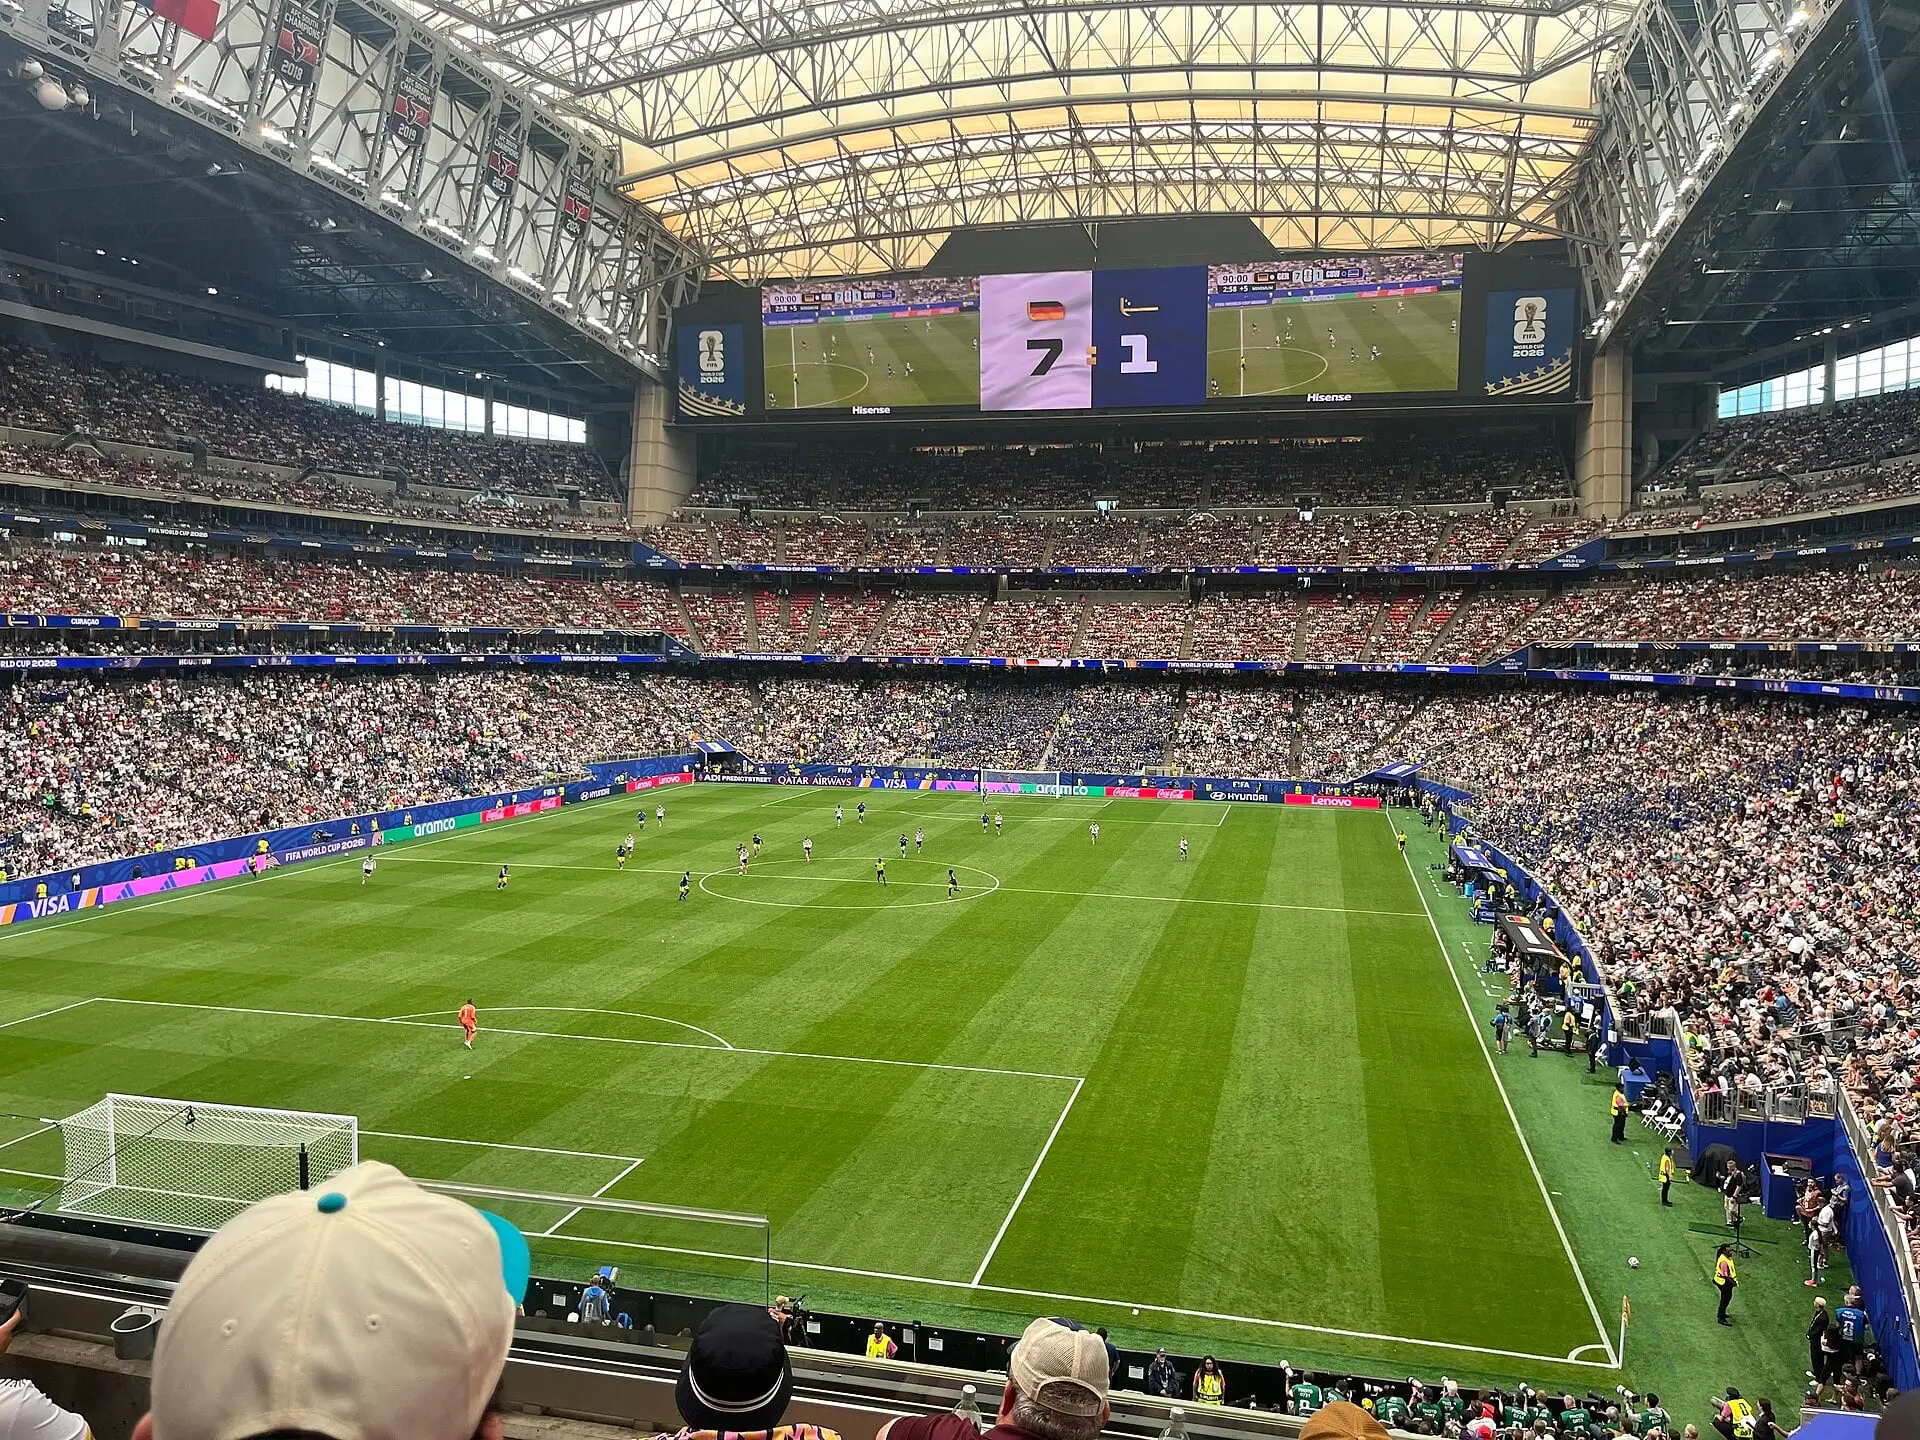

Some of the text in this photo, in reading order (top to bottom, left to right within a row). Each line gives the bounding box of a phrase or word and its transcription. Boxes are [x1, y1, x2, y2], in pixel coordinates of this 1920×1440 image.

[290, 7, 301, 18] AFC
[284, 12, 321, 40] CHAMPIONS
[281, 59, 303, 81] 2018
[400, 80, 432, 105] CHAMPIONS
[397, 123, 417, 142] 2019
[1222, 274, 1248, 284] 90:00
[774, 295, 797, 303] 90:00
[1026, 338, 1064, 376] 7
[1120, 334, 1158, 374] 1
[1512, 349, 1545, 358] 2026
[1306, 393, 1352, 402] Hisense
[852, 406, 891, 415] Hisense
[160, 528, 179, 536] WORLD
[415, 550, 448, 558] HOUSTON
[1796, 547, 1827, 556] HOUSTON
[70, 618, 100, 627] CURAÇAO
[16, 660, 31, 668] CUP
[31, 659, 58, 668] 2026
[777, 775, 852, 786] QATAR AIRWAYS
[881, 778, 908, 789] VISA
[1232, 781, 1250, 789] FIFA
[543, 788, 556, 797] FIFA
[589, 787, 611, 799] HYUNDAI
[1035, 783, 1089, 796] aramco
[1227, 792, 1268, 802] HYUNDAI
[1311, 793, 1352, 807] Lenovo
[413, 817, 456, 837] aramco
[285, 851, 301, 862] FIFA
[301, 845, 327, 859] WORLD
[327, 842, 341, 853] CUP
[26, 894, 70, 919] VISA
